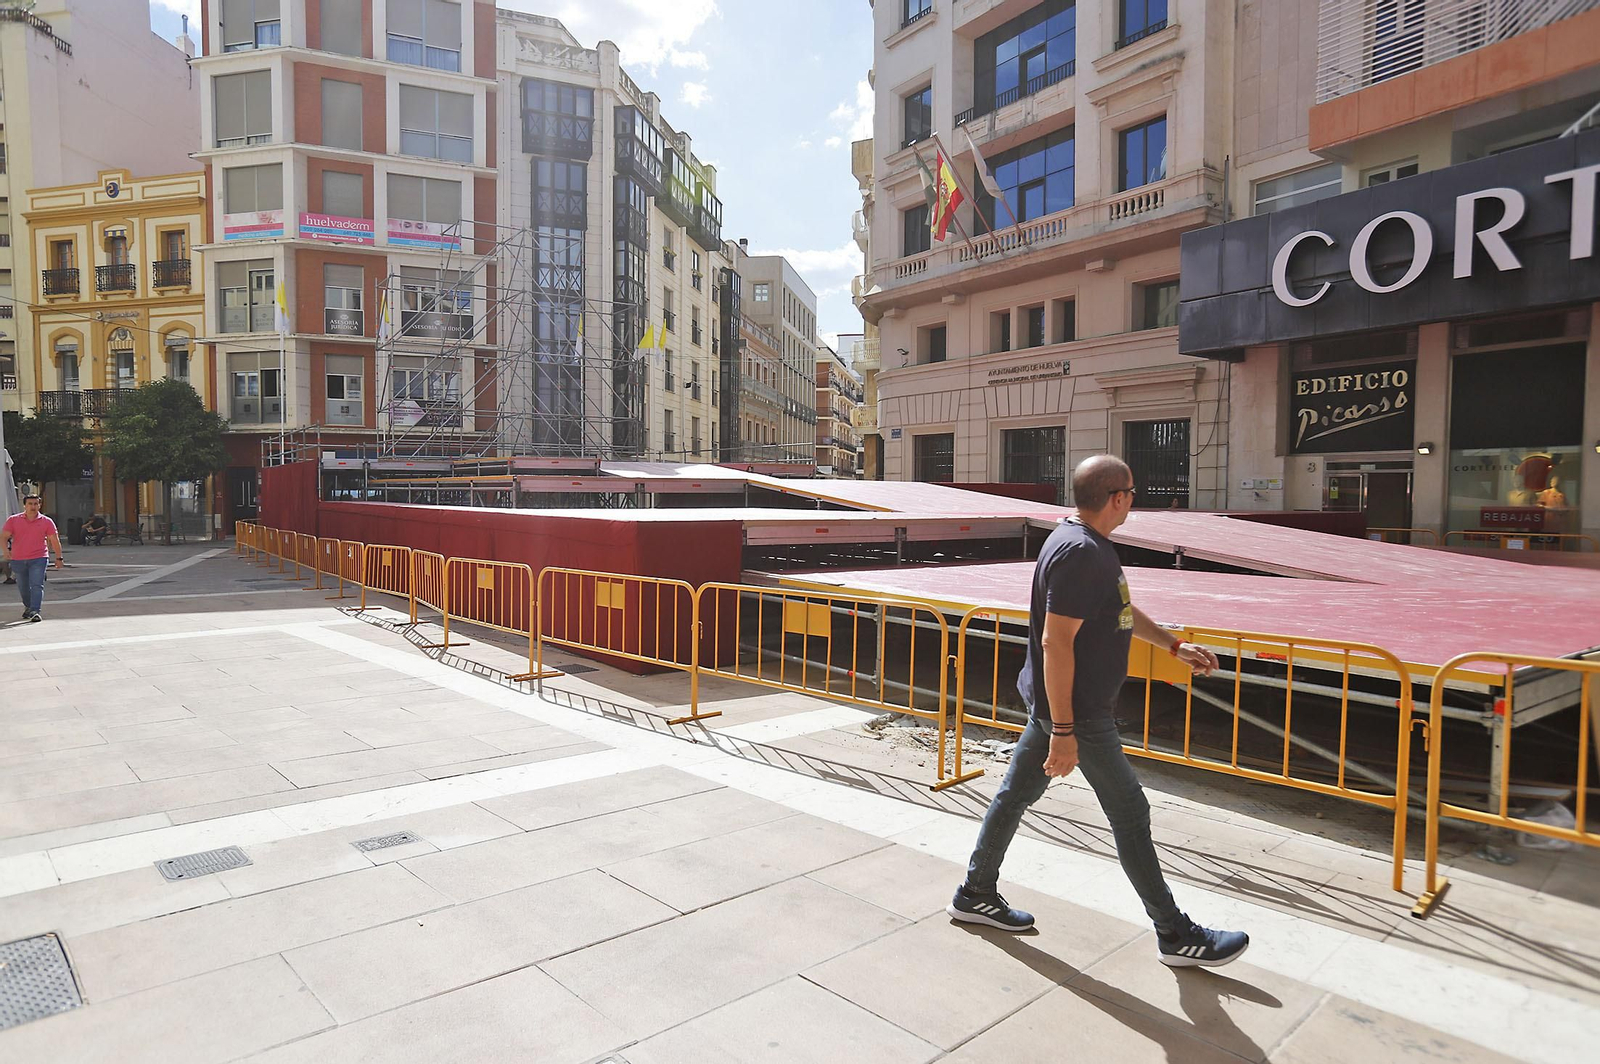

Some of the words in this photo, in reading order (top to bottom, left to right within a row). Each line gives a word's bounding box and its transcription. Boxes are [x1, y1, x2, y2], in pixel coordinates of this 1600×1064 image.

[306, 215, 370, 230] huelvaderm
[1271, 164, 1600, 307] CORT
[1039, 361, 1063, 370] HUELVA
[1296, 370, 1409, 396] EDIFICIO
[1295, 391, 1408, 449] Picasso
[1307, 462, 1316, 473] 3
[1483, 512, 1541, 522] REBAJAS
